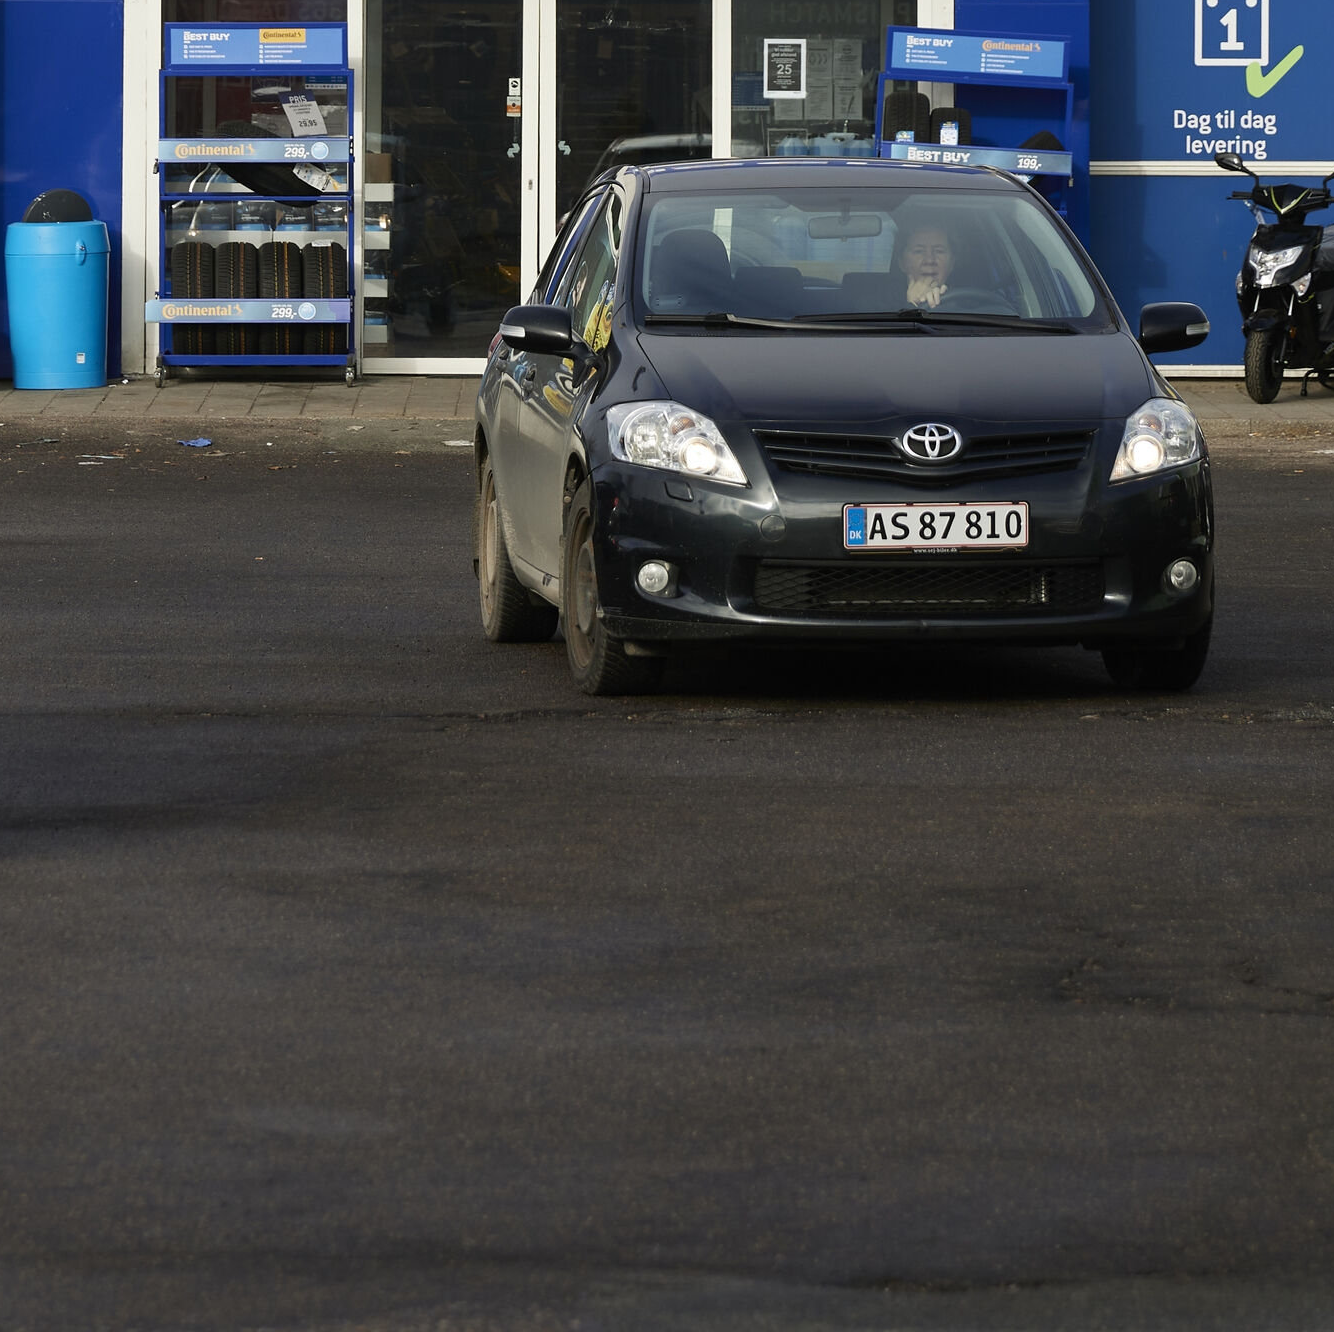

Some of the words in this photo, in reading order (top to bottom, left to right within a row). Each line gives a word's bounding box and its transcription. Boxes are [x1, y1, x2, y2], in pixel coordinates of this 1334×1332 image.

[184, 32, 208, 41] BEST
[210, 33, 230, 41] BUY
[1220, 9, 1244, 50] 1
[906, 35, 931, 46] BEST
[933, 39, 953, 48] BUY
[982, 40, 1033, 52] Continental
[777, 64, 792, 74] 25
[289, 95, 307, 104] PRIS
[1174, 110, 1211, 135] Dag
[1215, 110, 1235, 129] til
[1240, 110, 1277, 135] dag
[175, 144, 244, 158] Continental
[1186, 135, 1267, 160] levering
[908, 147, 941, 162] BEST
[943, 152, 970, 163] BUY
[162, 304, 232, 319] Continental
[869, 512, 910, 540] AS
[919, 511, 956, 540] 87
[965, 510, 1022, 539] 810
[850, 531, 862, 540] DK
